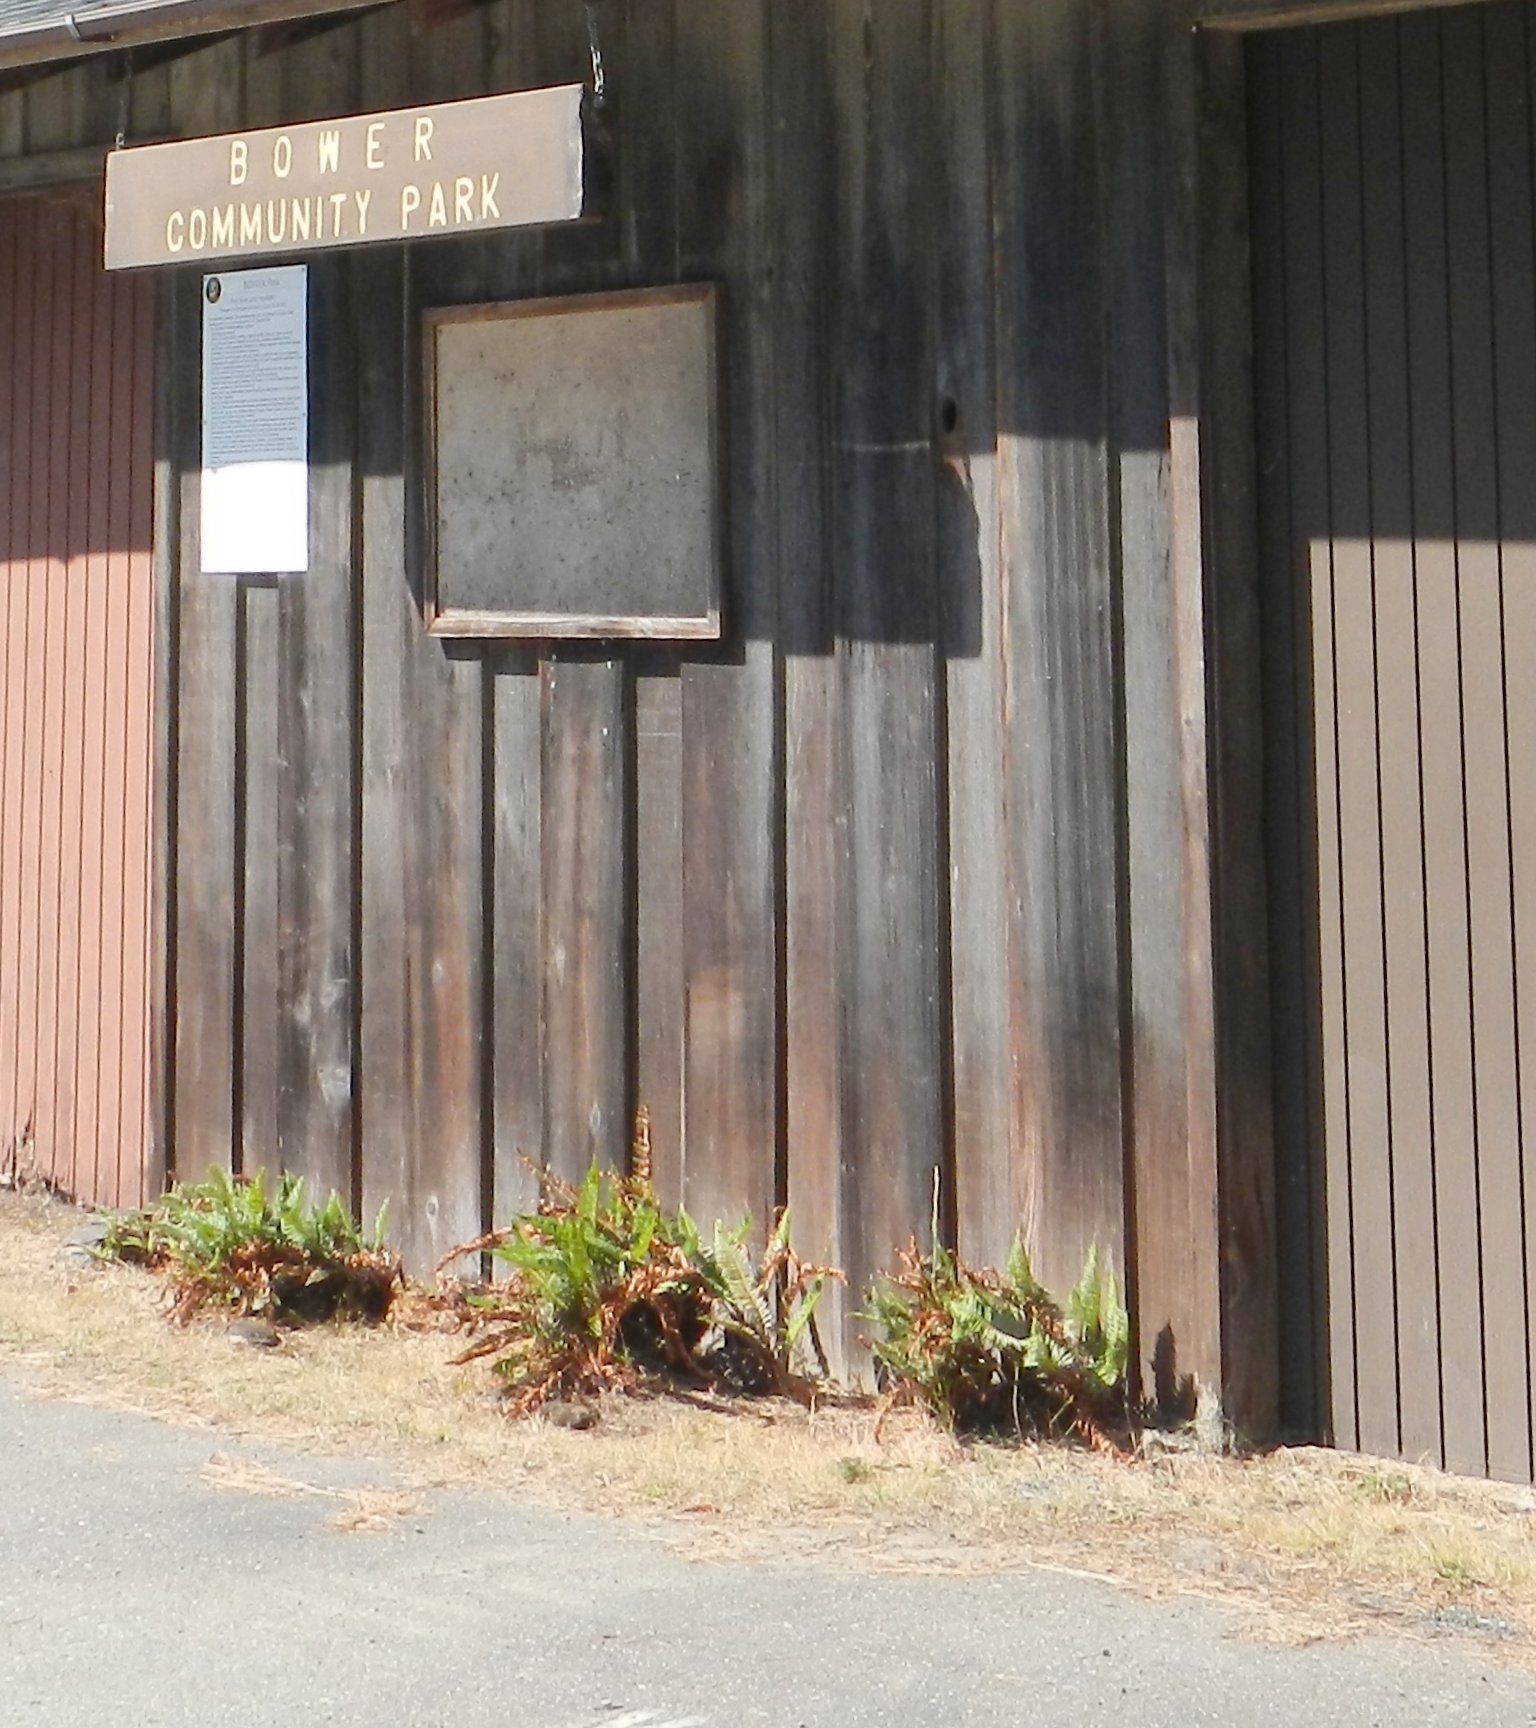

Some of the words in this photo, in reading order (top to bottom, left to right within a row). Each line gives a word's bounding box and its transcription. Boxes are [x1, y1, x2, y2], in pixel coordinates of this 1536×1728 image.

[229, 116, 436, 186] BOWER
[166, 189, 372, 253] COMMUNITY
[400, 173, 501, 231] PARK
